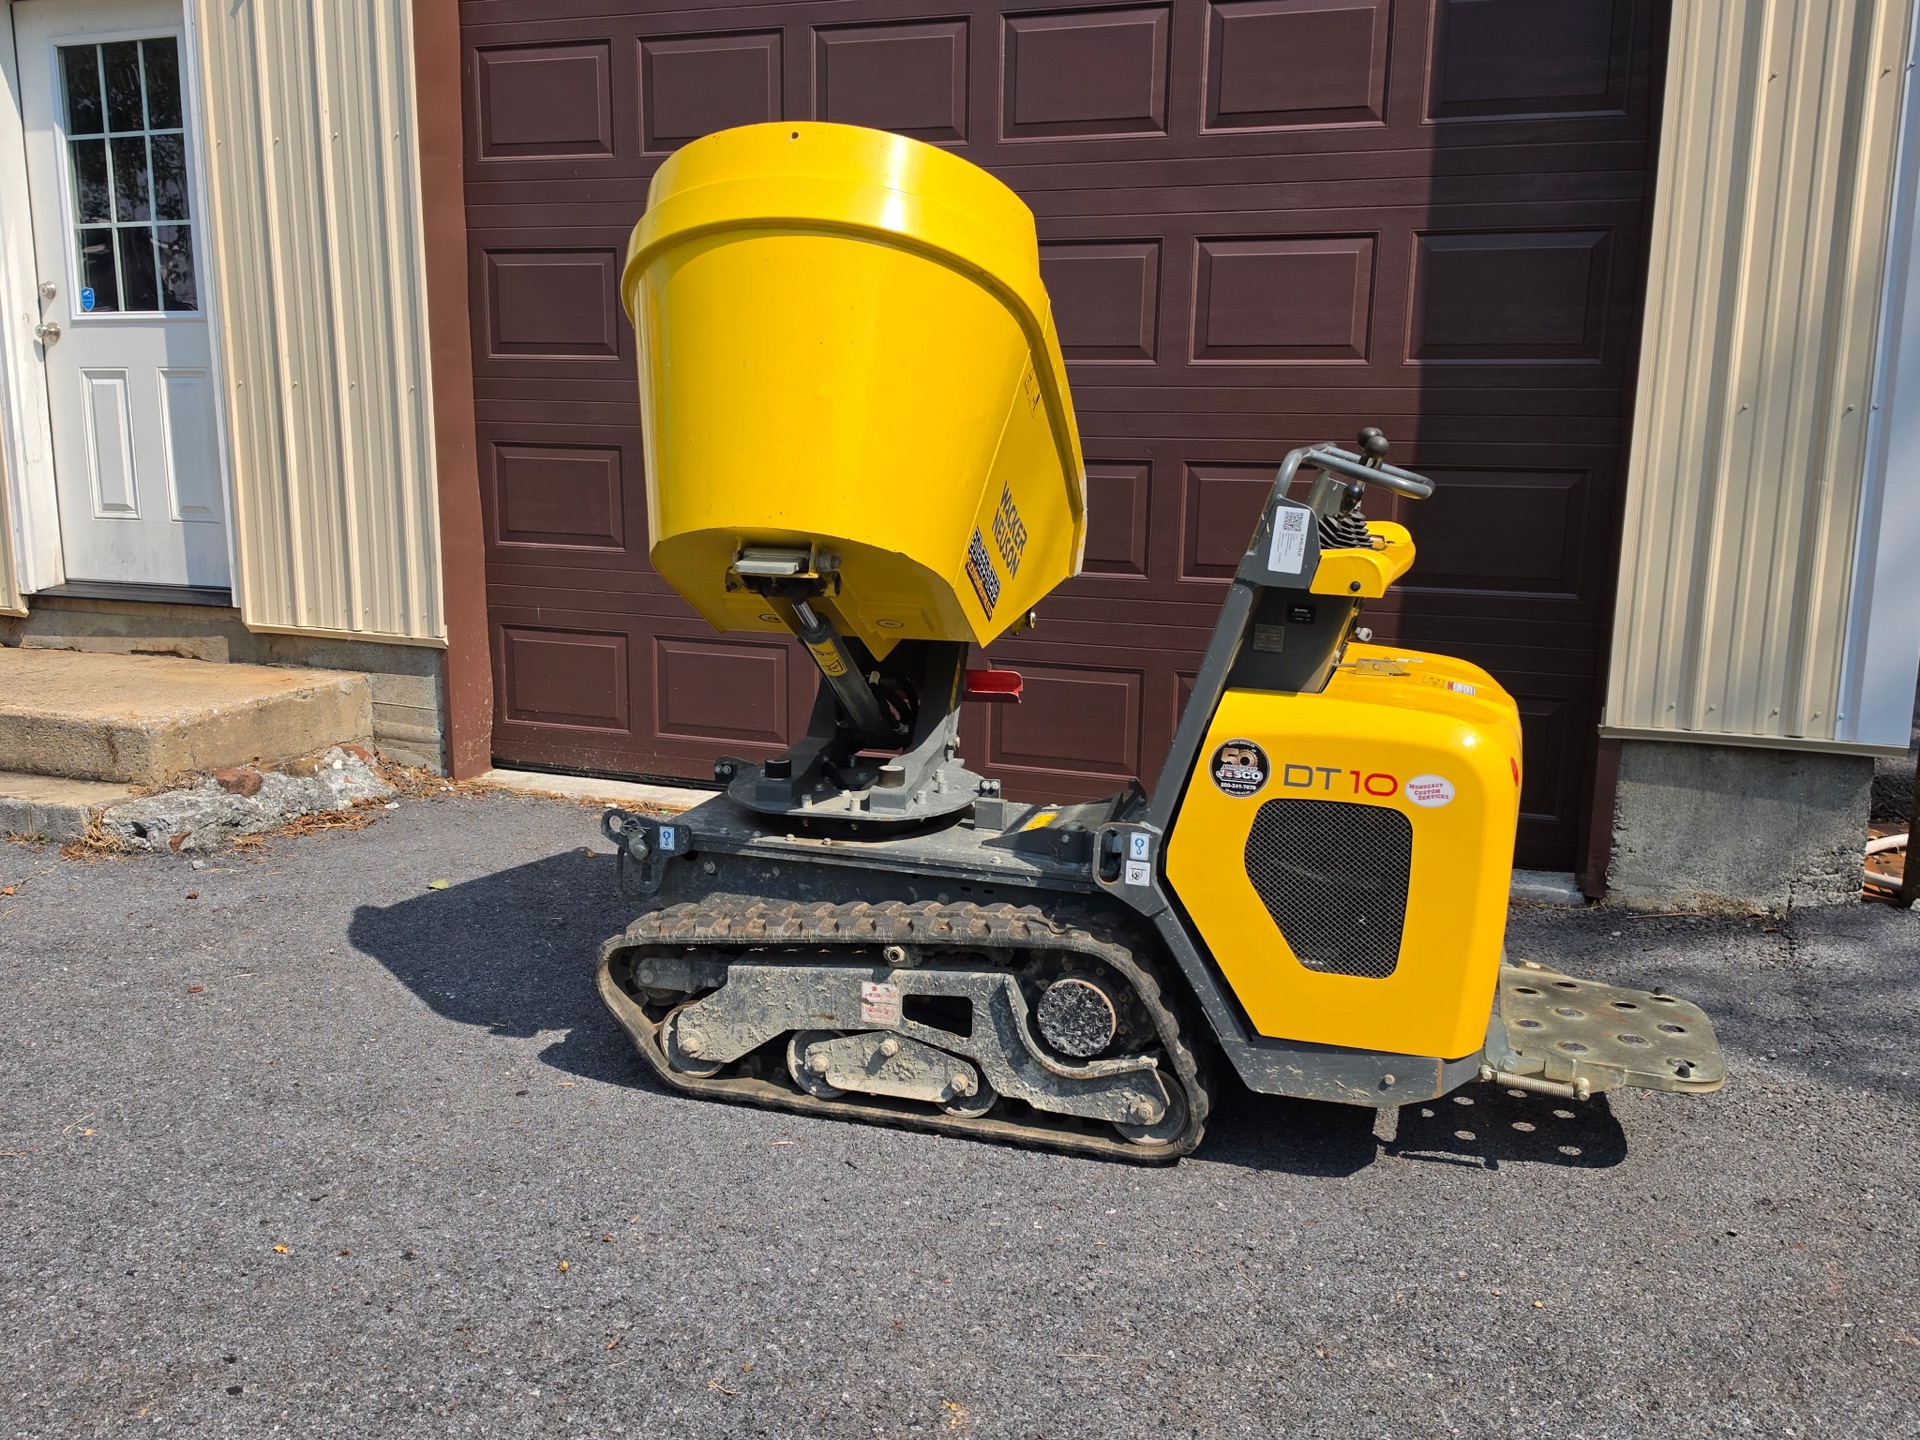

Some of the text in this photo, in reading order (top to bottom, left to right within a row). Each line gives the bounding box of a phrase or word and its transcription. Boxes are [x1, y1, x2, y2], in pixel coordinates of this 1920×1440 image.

[1000, 480, 1027, 557] WACKER
[991, 507, 1020, 581] NEUSON
[1215, 769, 1263, 780] JESCO
[1283, 763, 1399, 797] DT 10
[1414, 788, 1441, 796] CUSTOM
[1417, 793, 1450, 801] SERVICES
